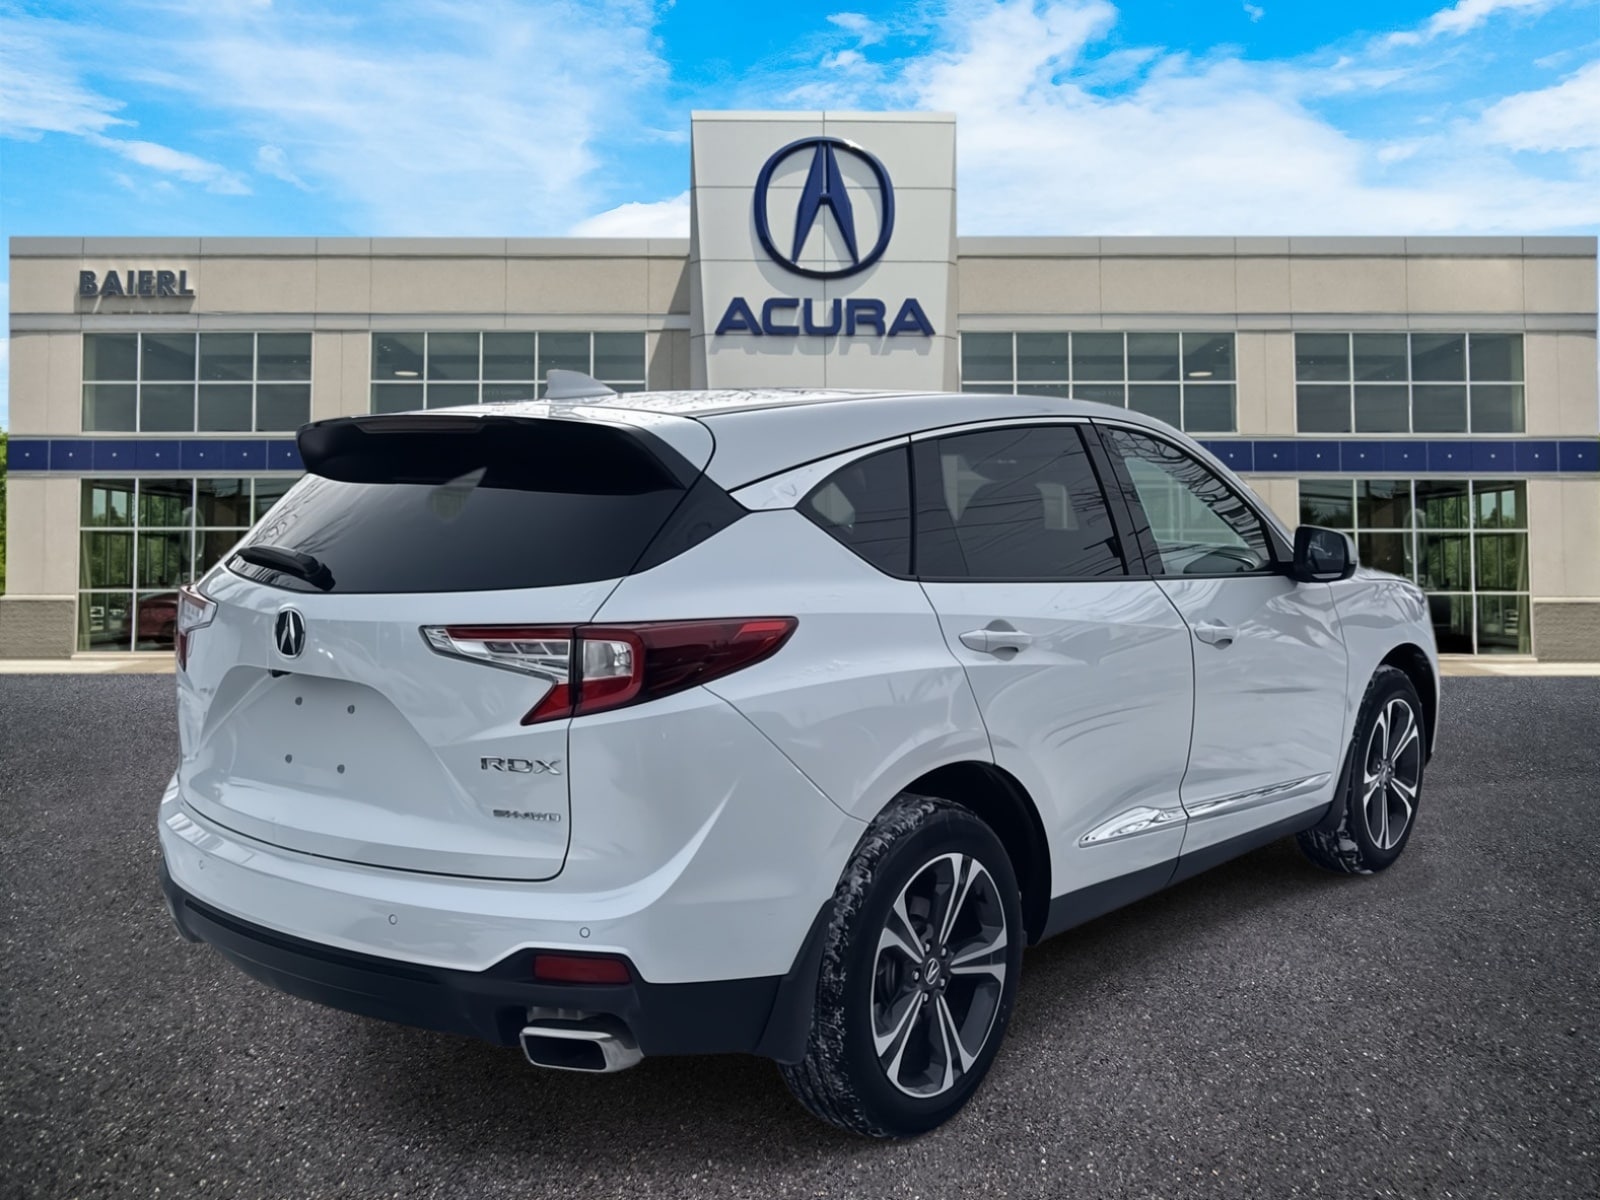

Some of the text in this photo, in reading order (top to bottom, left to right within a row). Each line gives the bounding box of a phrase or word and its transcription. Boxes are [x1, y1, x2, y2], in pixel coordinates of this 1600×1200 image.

[79, 270, 195, 297] BAIERL
[714, 297, 936, 336] ACURA
[480, 756, 562, 776] RDX
